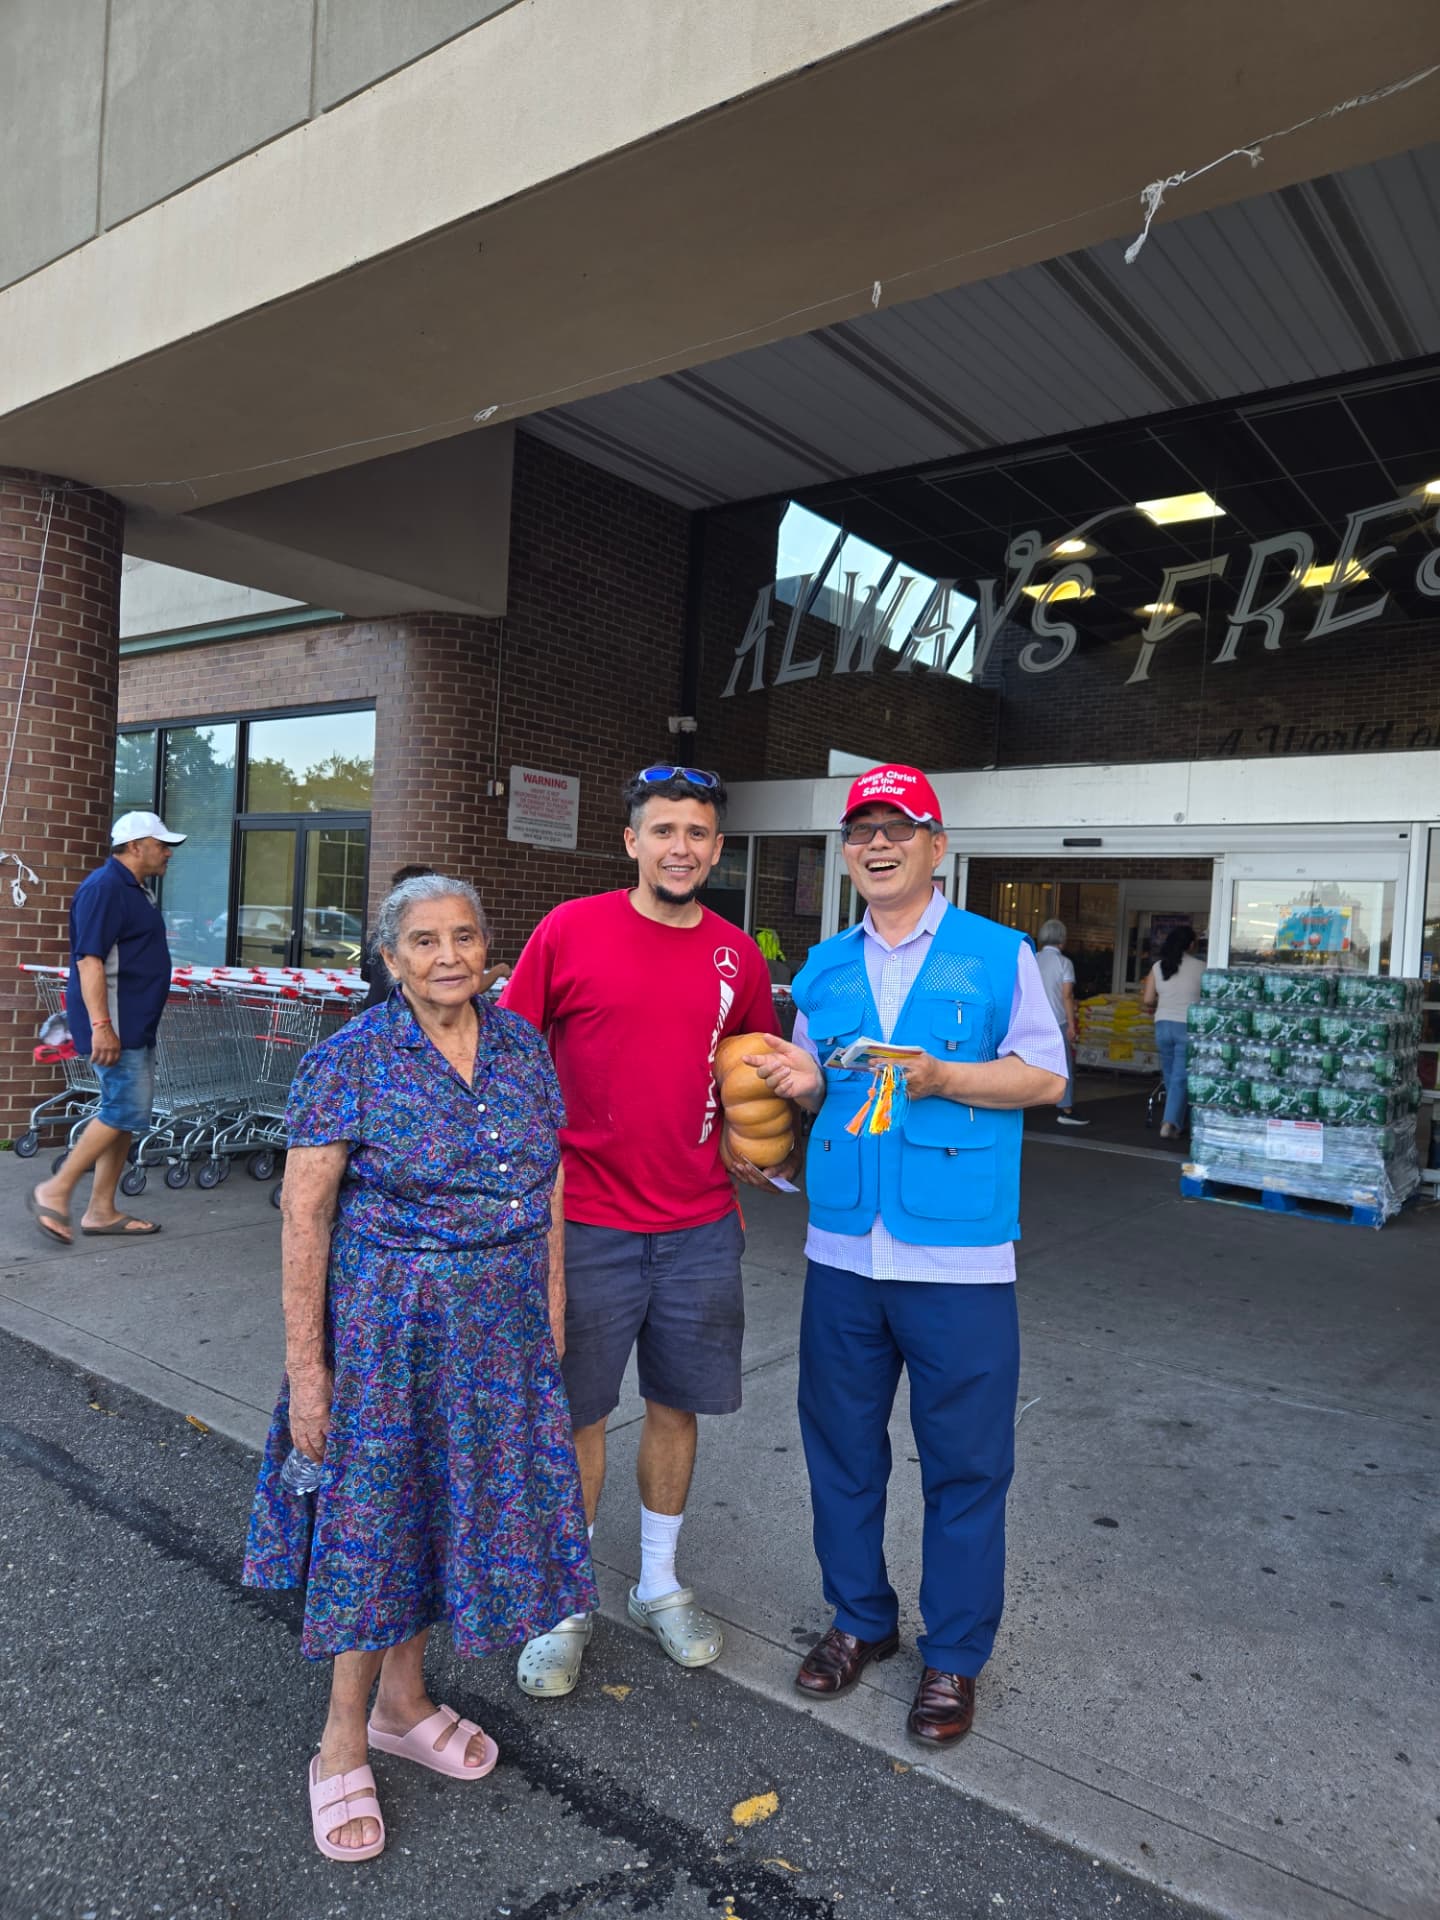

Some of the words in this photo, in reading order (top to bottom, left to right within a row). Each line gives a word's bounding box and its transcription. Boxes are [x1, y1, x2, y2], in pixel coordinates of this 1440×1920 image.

[720, 529, 1095, 698] ALWAYS
[523, 773, 568, 790] WARNING
[858, 772, 883, 786] Jesus
[886, 770, 917, 784] Christ
[880, 777, 895, 785] the
[862, 783, 906, 797] Saviour
